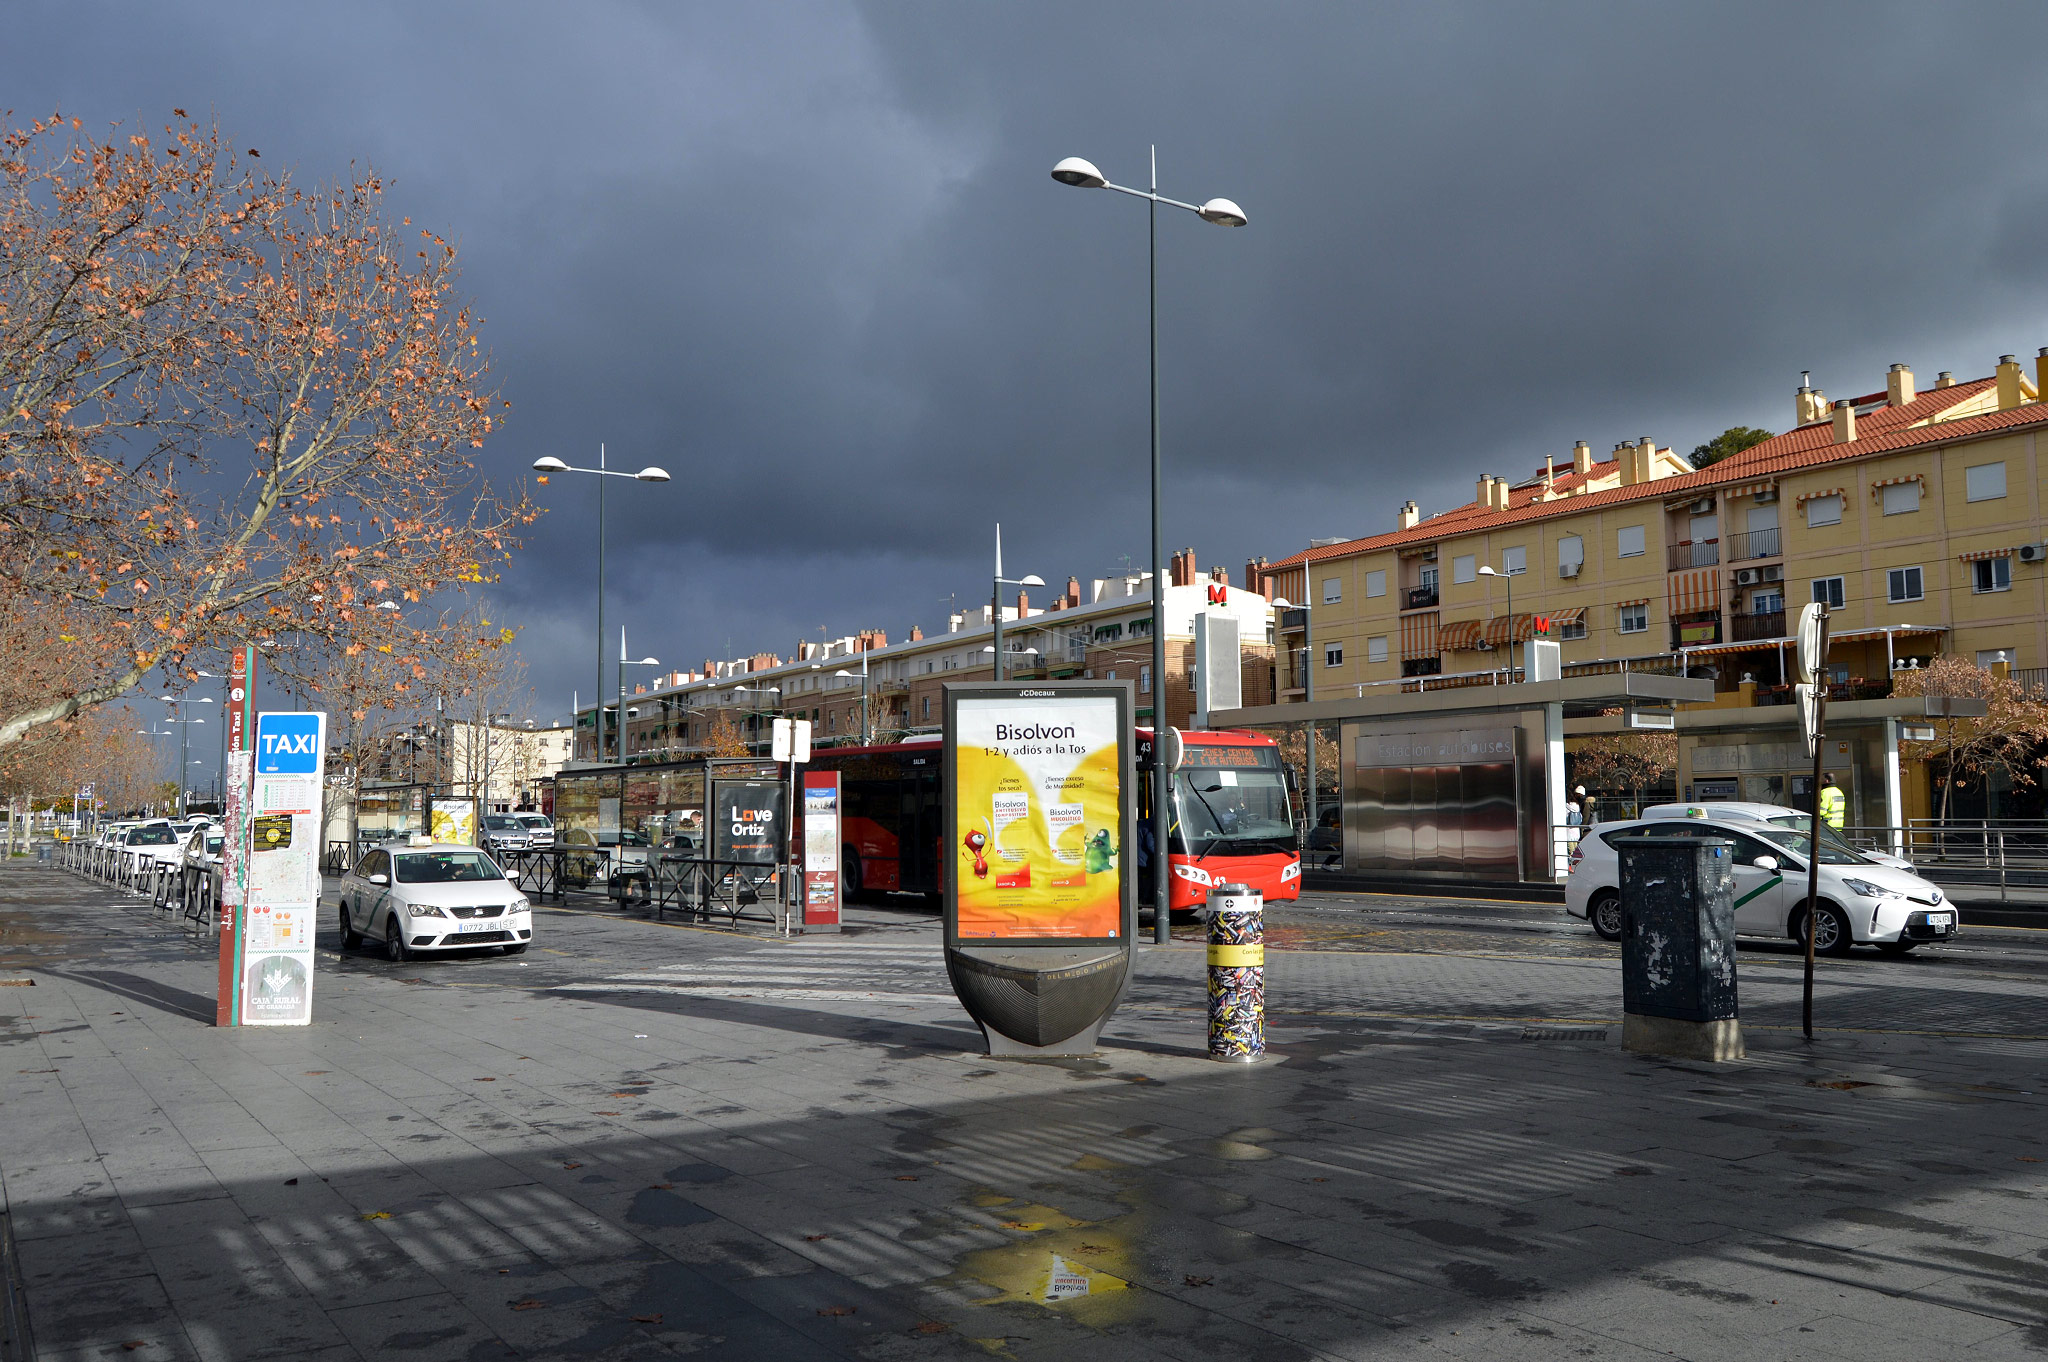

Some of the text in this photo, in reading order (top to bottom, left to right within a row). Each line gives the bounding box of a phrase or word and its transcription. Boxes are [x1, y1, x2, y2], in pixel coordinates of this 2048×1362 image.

[232, 712, 242, 734] Taxi
[996, 723, 1075, 740] Bisolvon
[262, 734, 316, 754] TAXI
[1140, 742, 1151, 752] 43
[1378, 740, 1512, 758] Estación autobuses
[984, 747, 1000, 756] 1-2
[1002, 748, 1009, 758] y
[1012, 744, 1042, 756] adiós
[1056, 744, 1066, 754] la
[1068, 744, 1086, 754] Tos
[1219, 756, 1259, 766] AUTOBUSES
[330, 776, 348, 784] WC
[732, 806, 773, 822] Love
[732, 823, 764, 836] Ortiz
[463, 922, 499, 932] 0772 JBL
[502, 920, 515, 928] SP
